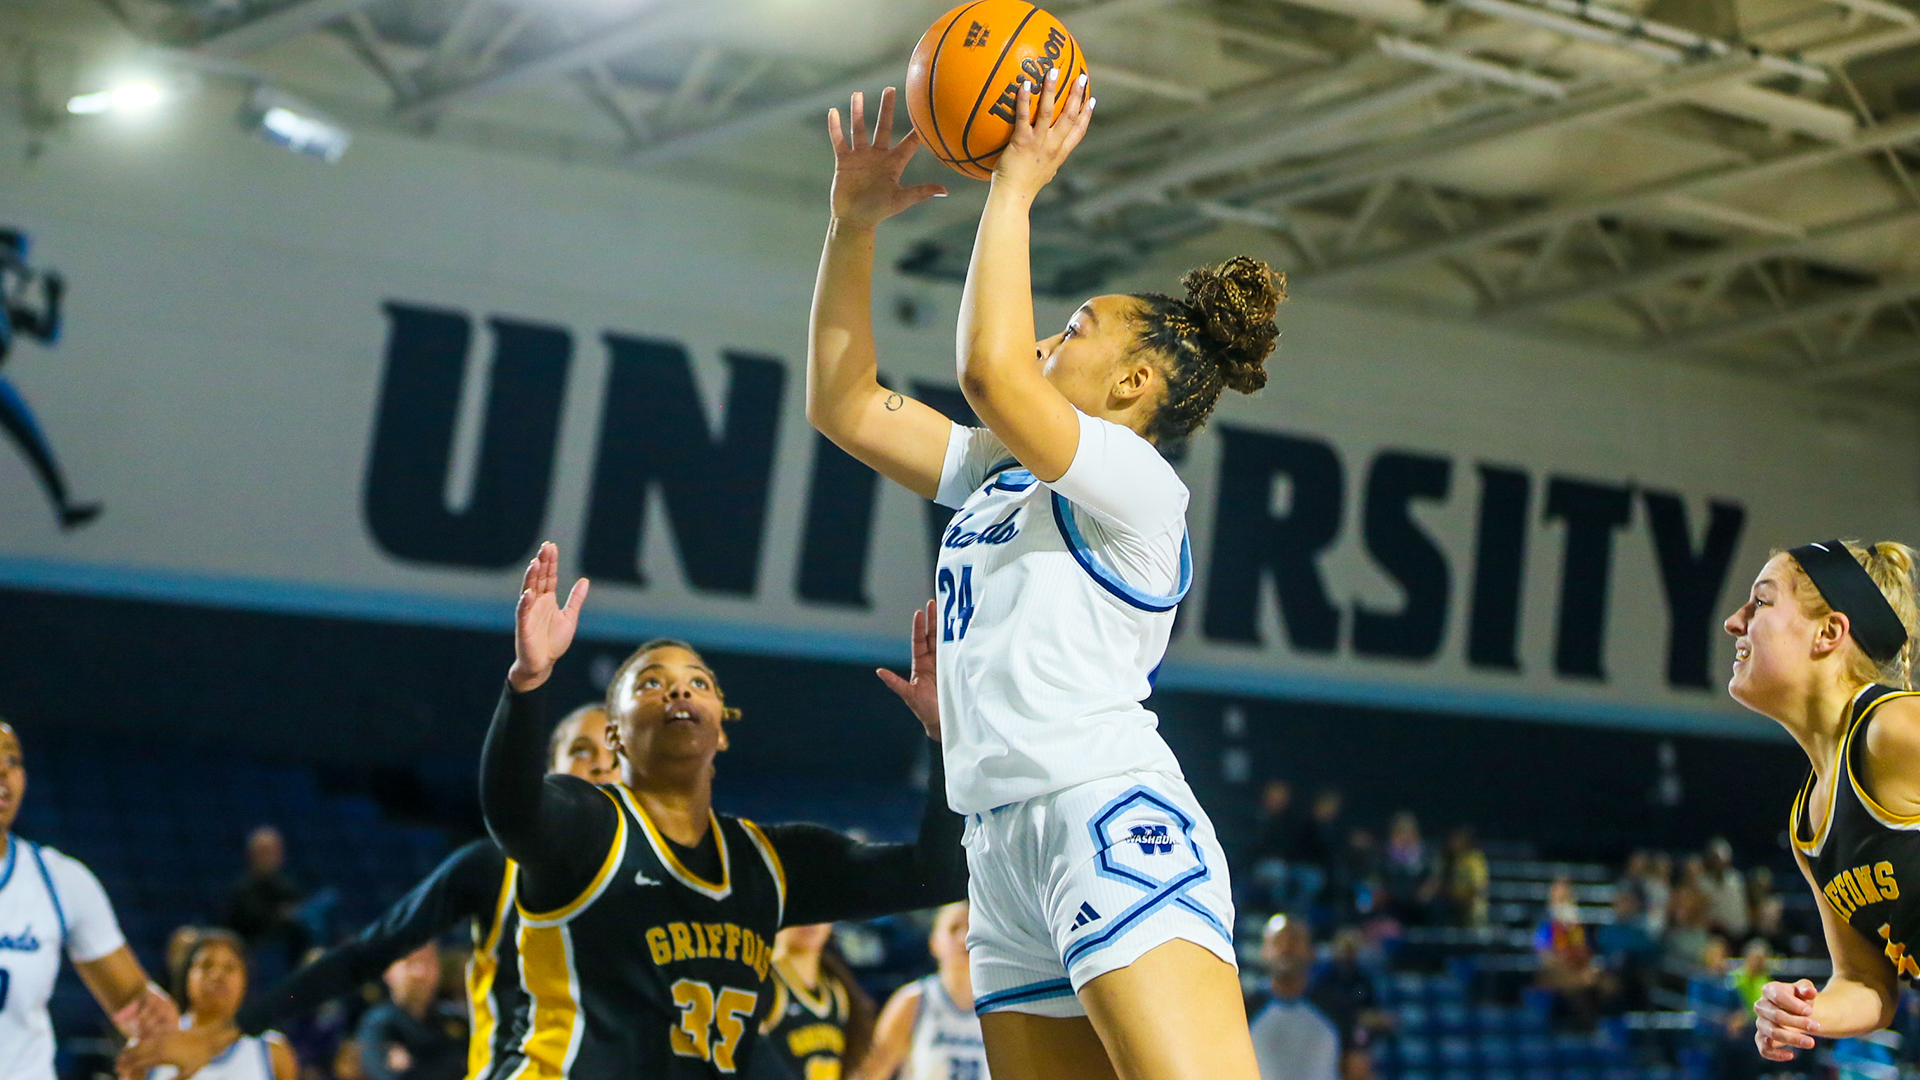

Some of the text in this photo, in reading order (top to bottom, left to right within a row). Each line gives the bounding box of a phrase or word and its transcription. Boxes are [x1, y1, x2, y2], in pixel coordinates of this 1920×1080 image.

[361, 301, 1745, 694] UNIRSITY
[937, 565, 975, 643] 24
[1823, 860, 1900, 923] FFONS
[670, 978, 757, 1073] 35
